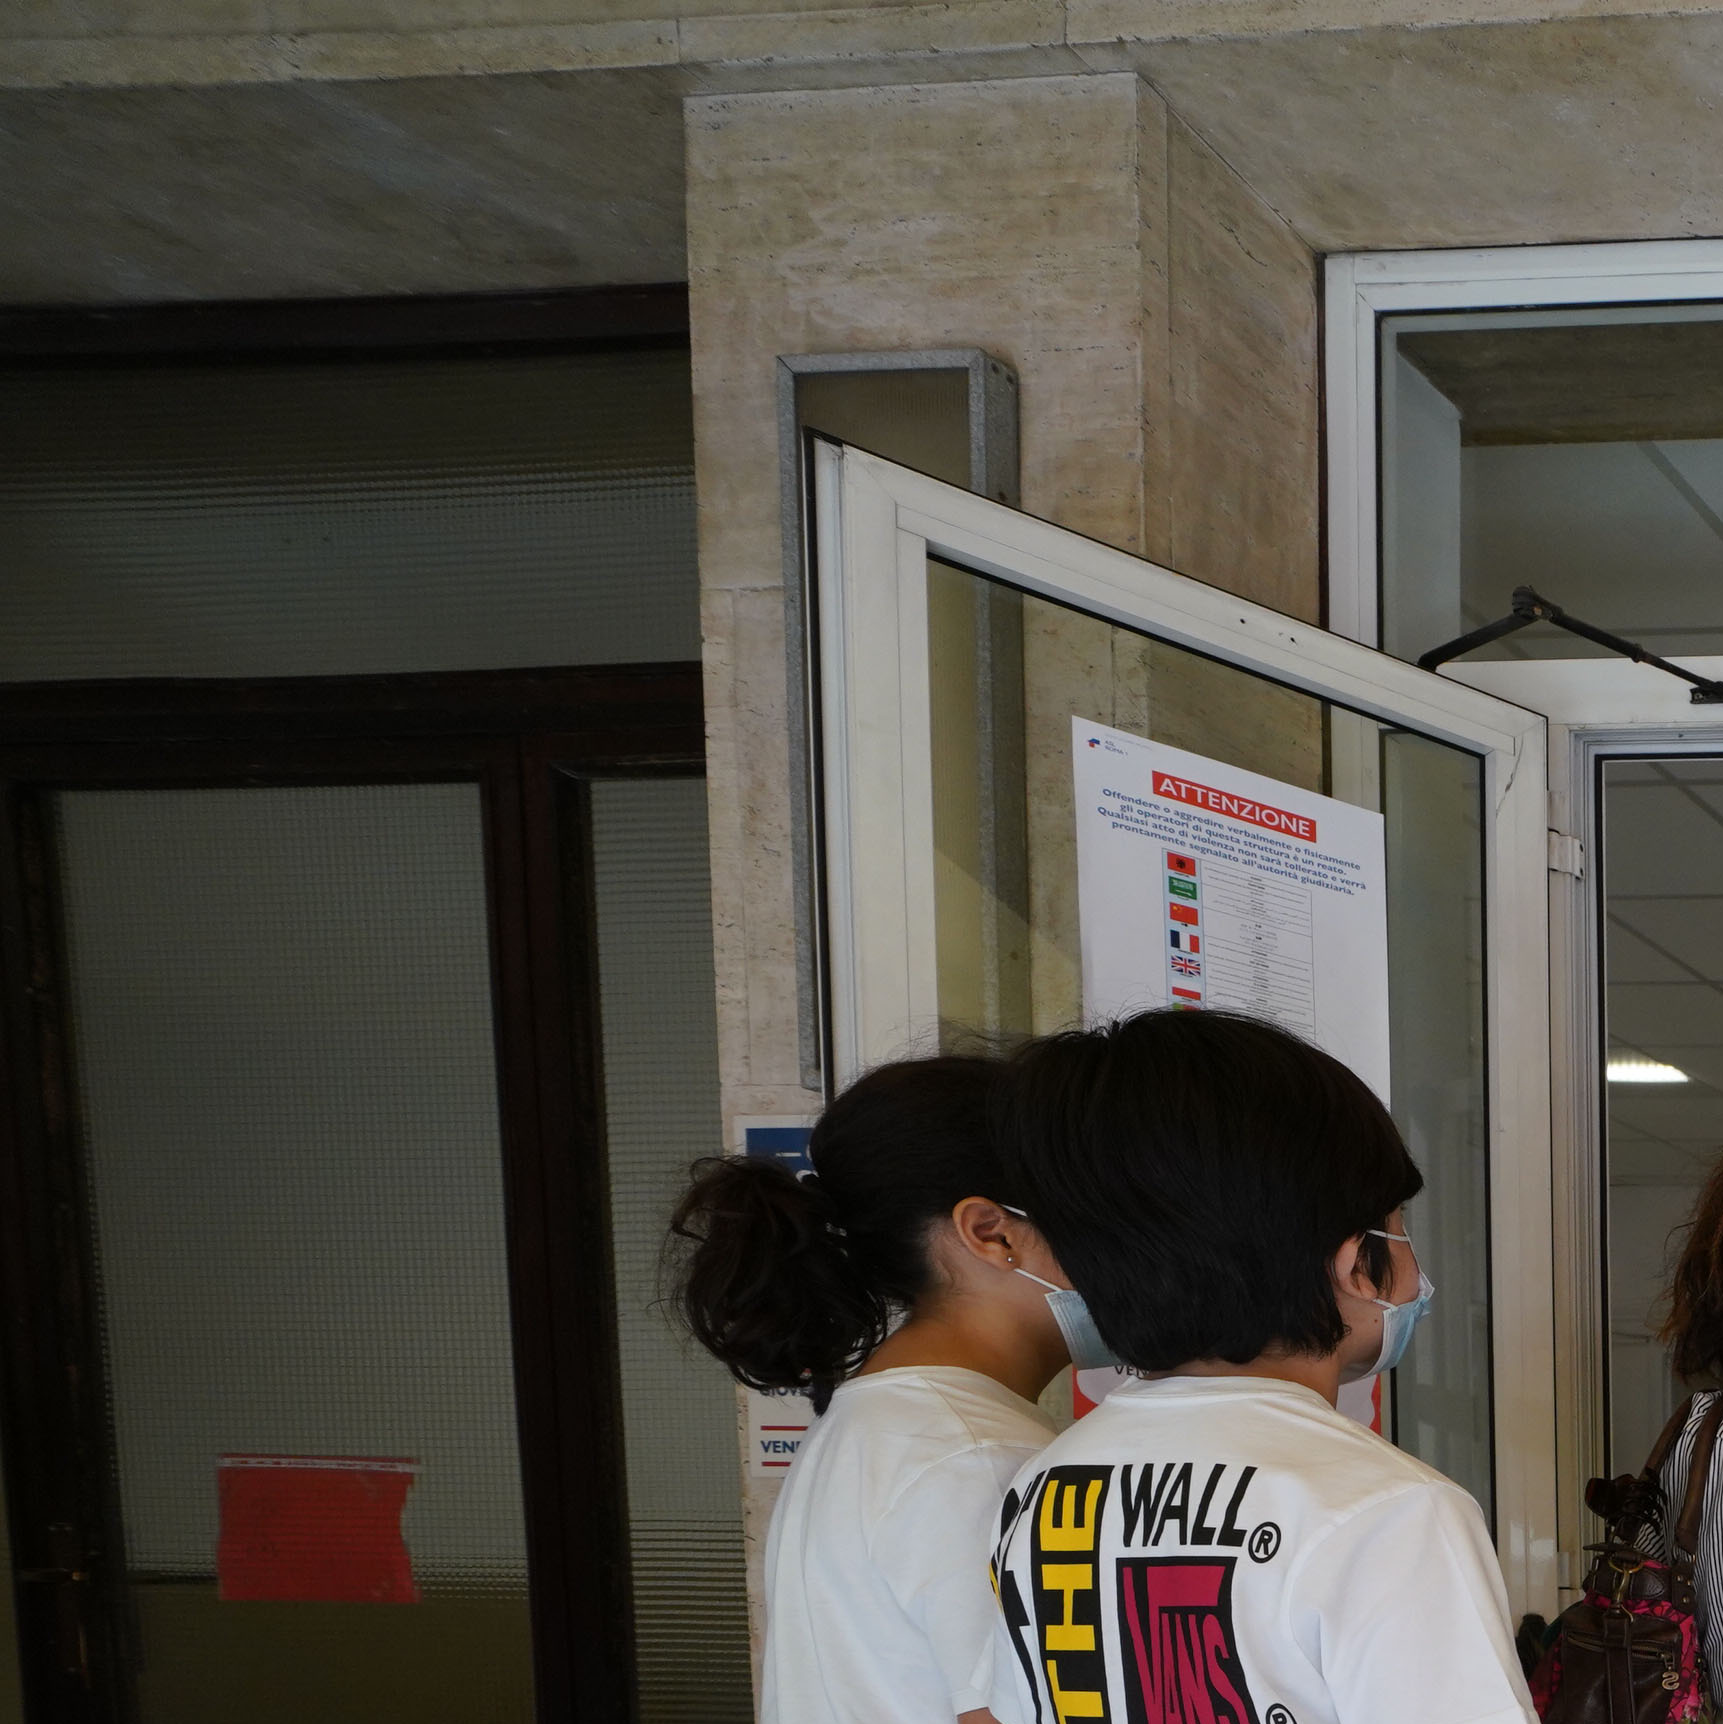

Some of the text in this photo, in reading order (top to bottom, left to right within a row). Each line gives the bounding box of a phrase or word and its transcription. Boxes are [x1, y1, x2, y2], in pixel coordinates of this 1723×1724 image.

[1102, 788, 1160, 811] Offendere
[1173, 809, 1224, 831] aggredire
[1228, 826, 1292, 851] verbalmente
[1303, 847, 1361, 871] fisicamente
[1112, 821, 1186, 849] prontamente
[1189, 842, 1239, 864] segnalato
[1119, 803, 1133, 814] gli
[1136, 807, 1189, 831] operatori
[1192, 822, 1203, 832] di
[1206, 828, 1240, 846] questa
[1243, 838, 1290, 861] struttura
[1301, 857, 1314, 866] un
[1317, 861, 1347, 876] reato.
[1159, 777, 1311, 838] ATTENZIONE
[1097, 805, 1367, 891] Qualsiasi atto di violenza non sarà tollerato e verrà
